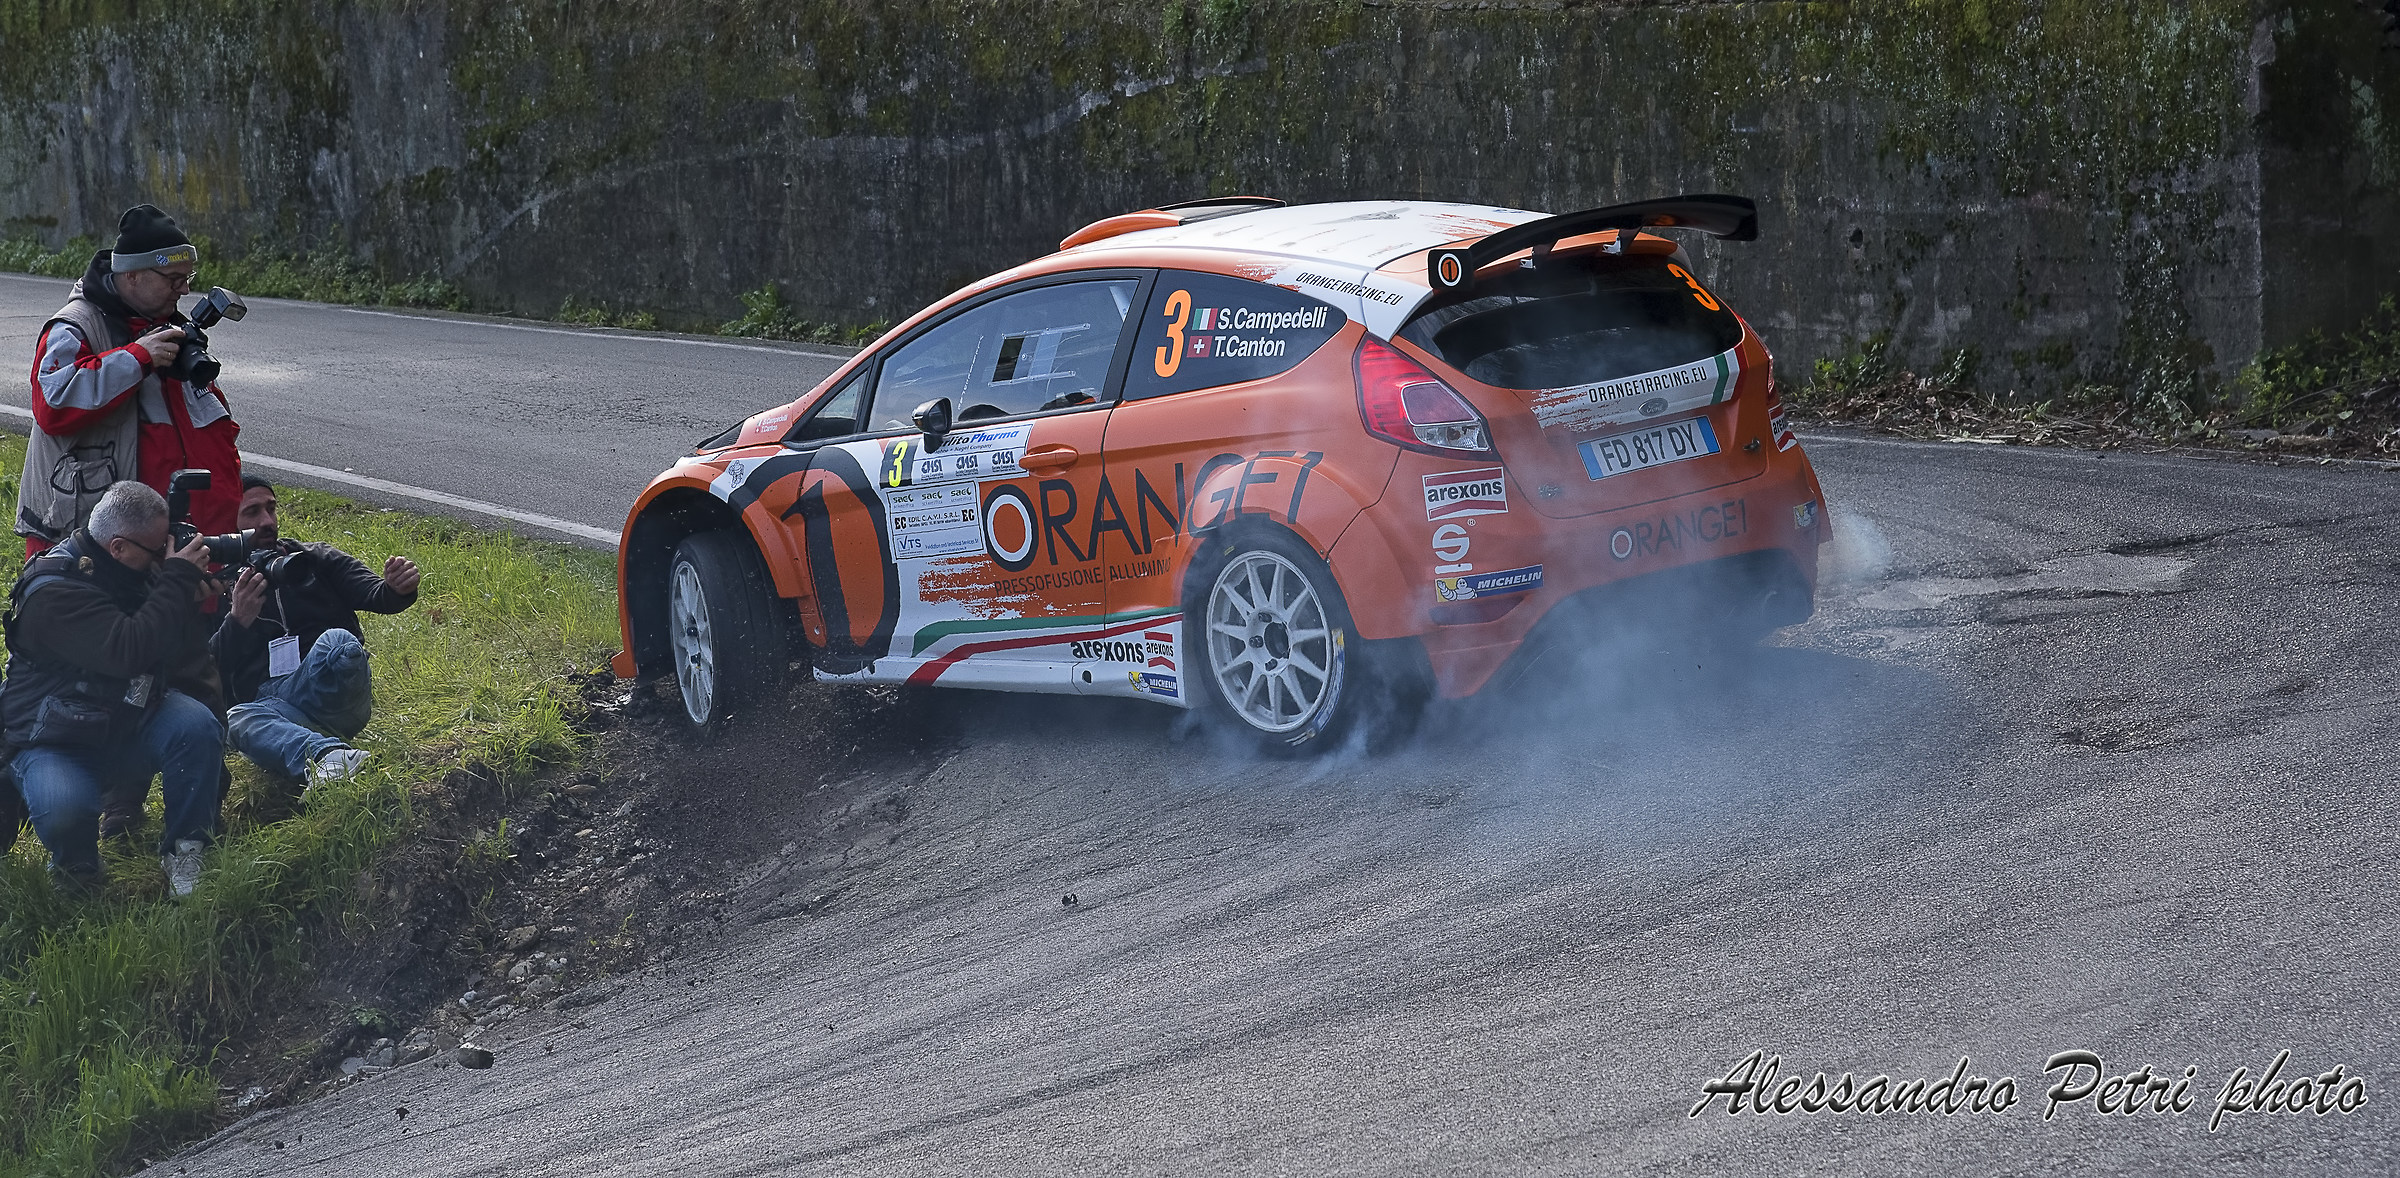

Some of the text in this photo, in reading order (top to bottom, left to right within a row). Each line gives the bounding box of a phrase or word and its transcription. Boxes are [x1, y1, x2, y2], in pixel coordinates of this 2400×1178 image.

[1296, 272, 1403, 306] ORANGE1RACING.EU
[1667, 264, 1720, 311] 3
[1154, 289, 1192, 378] 3
[1217, 306, 1328, 334] S.Campedelli
[1214, 335, 1286, 358] T.Canton
[1588, 366, 1707, 403] ORANGE1RACING.EU
[971, 430, 1020, 443] Pharma
[1599, 424, 1698, 472] FD 817 DY
[888, 441, 908, 487] 3
[1427, 481, 1503, 503] arexons
[894, 516, 907, 530] EC
[961, 508, 975, 522] EC
[982, 451, 1324, 572] ORANGE1
[899, 535, 922, 550] VTS
[1609, 498, 1747, 562] ORANGE1
[994, 567, 1103, 596] PRESSOFUSIONE
[1477, 571, 1542, 589] MICHELIN
[1070, 641, 1145, 664] arexons
[1146, 641, 1174, 657] arexons
[1149, 678, 1177, 690] MICHELIN
